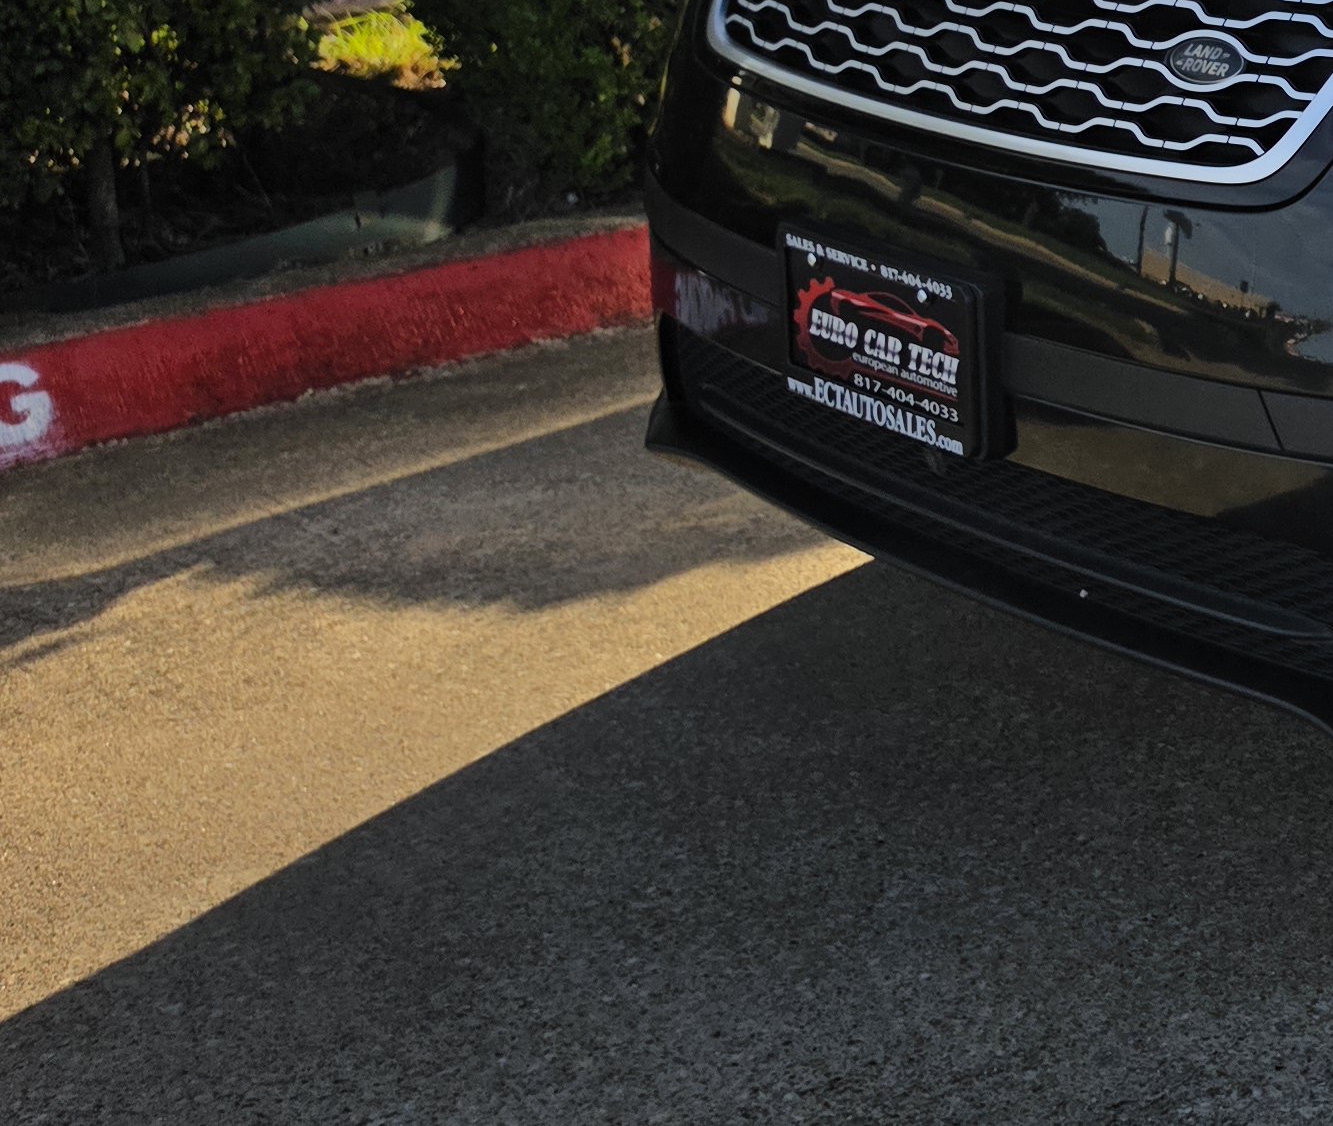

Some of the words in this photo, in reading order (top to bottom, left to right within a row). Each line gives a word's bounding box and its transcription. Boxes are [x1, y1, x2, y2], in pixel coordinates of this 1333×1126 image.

[1181, 58, 1230, 77] ROVER
[1184, 44, 1222, 60] LAND
[786, 233, 815, 254] SALES
[826, 246, 869, 271] SERVICE
[880, 264, 953, 300] 817-404-4033
[809, 308, 858, 349] EURO
[864, 328, 902, 365] CAR
[908, 342, 960, 385] TECH
[852, 351, 899, 376] european
[900, 369, 958, 398] automotive
[853, 373, 959, 423] 817-404-4033
[787, 376, 964, 456] www.ECTAUTOSALES.com
